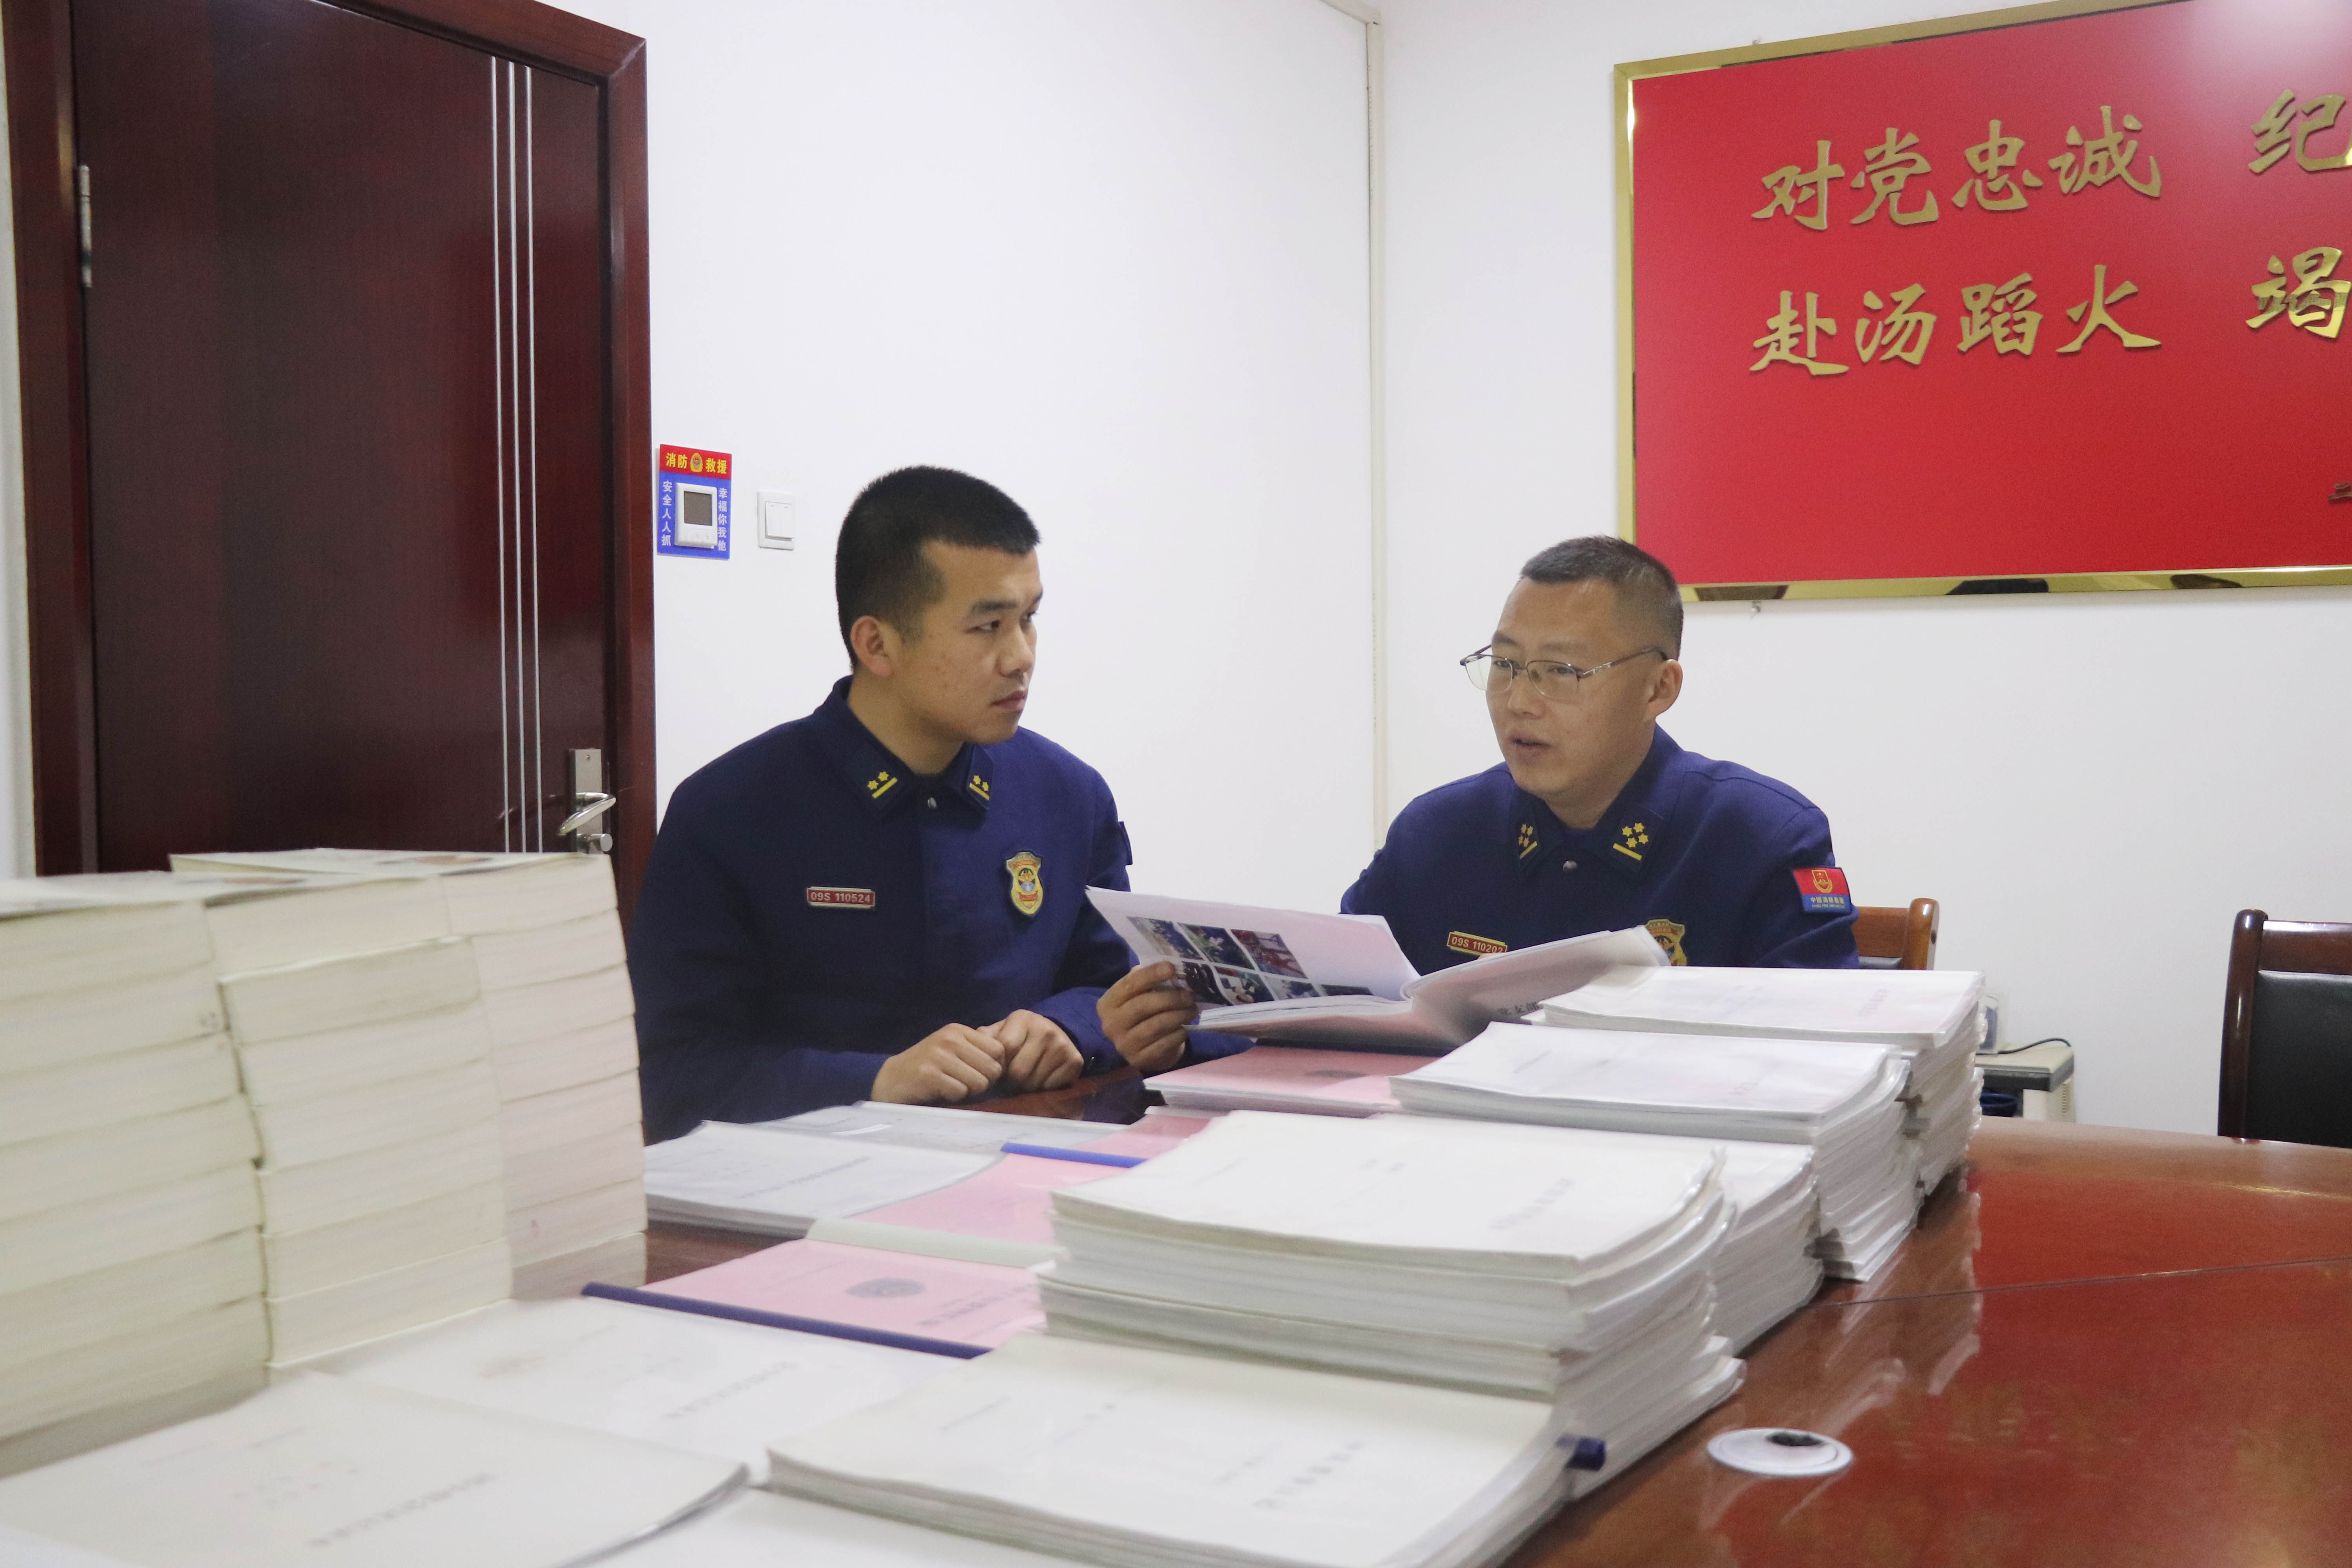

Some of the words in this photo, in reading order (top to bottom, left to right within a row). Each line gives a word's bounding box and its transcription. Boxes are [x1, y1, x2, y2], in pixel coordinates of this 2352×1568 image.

[1751, 105, 2161, 230] 对党忠诚
[2248, 89, 2352, 172] 纪
[1749, 264, 2161, 375] 赴汤蹈火
[2245, 247, 2352, 338] 竭
[666, 452, 688, 469] 消防
[706, 457, 727, 474] 救援
[662, 481, 673, 546] 安全人人抓
[718, 488, 728, 551] 幸福你我他
[811, 892, 831, 901] 09S
[835, 893, 871, 903] 110524
[1452, 936, 1469, 947] 09S
